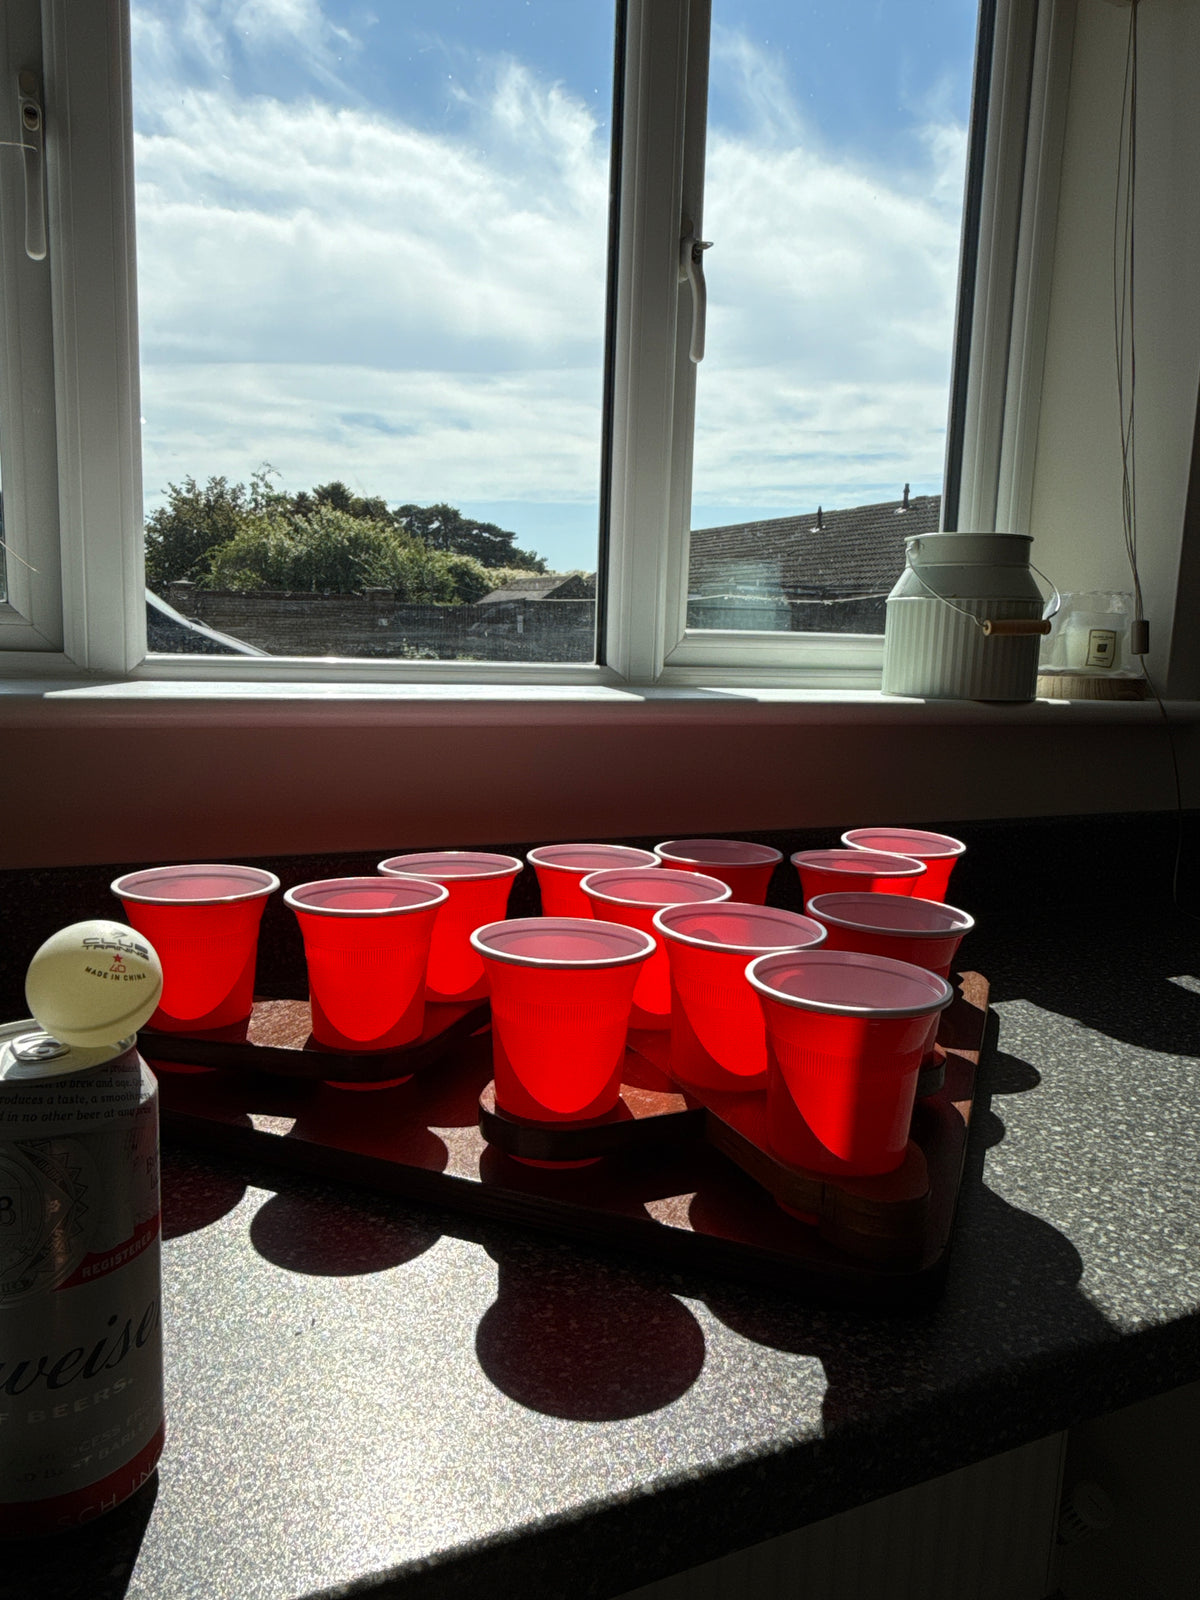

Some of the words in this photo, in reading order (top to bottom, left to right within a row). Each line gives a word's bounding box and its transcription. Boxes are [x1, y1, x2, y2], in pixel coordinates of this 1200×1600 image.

[82, 945, 149, 960] TRAINING
[83, 937, 148, 954] CLUB
[85, 966, 107, 979] MADE
[111, 973, 120, 981] IN
[124, 972, 146, 982] CHINA
[109, 963, 126, 973] 40
[96, 1077, 114, 1088] and
[47, 1096, 54, 1105] a
[57, 1094, 88, 1106] taste,
[91, 1096, 98, 1104] a
[7, 1112, 18, 1122] in
[22, 1112, 38, 1122] no
[41, 1109, 73, 1121] other
[77, 1108, 100, 1121] beer
[104, 1108, 114, 1118] at
[82, 1230, 152, 1279] REGISTERED
